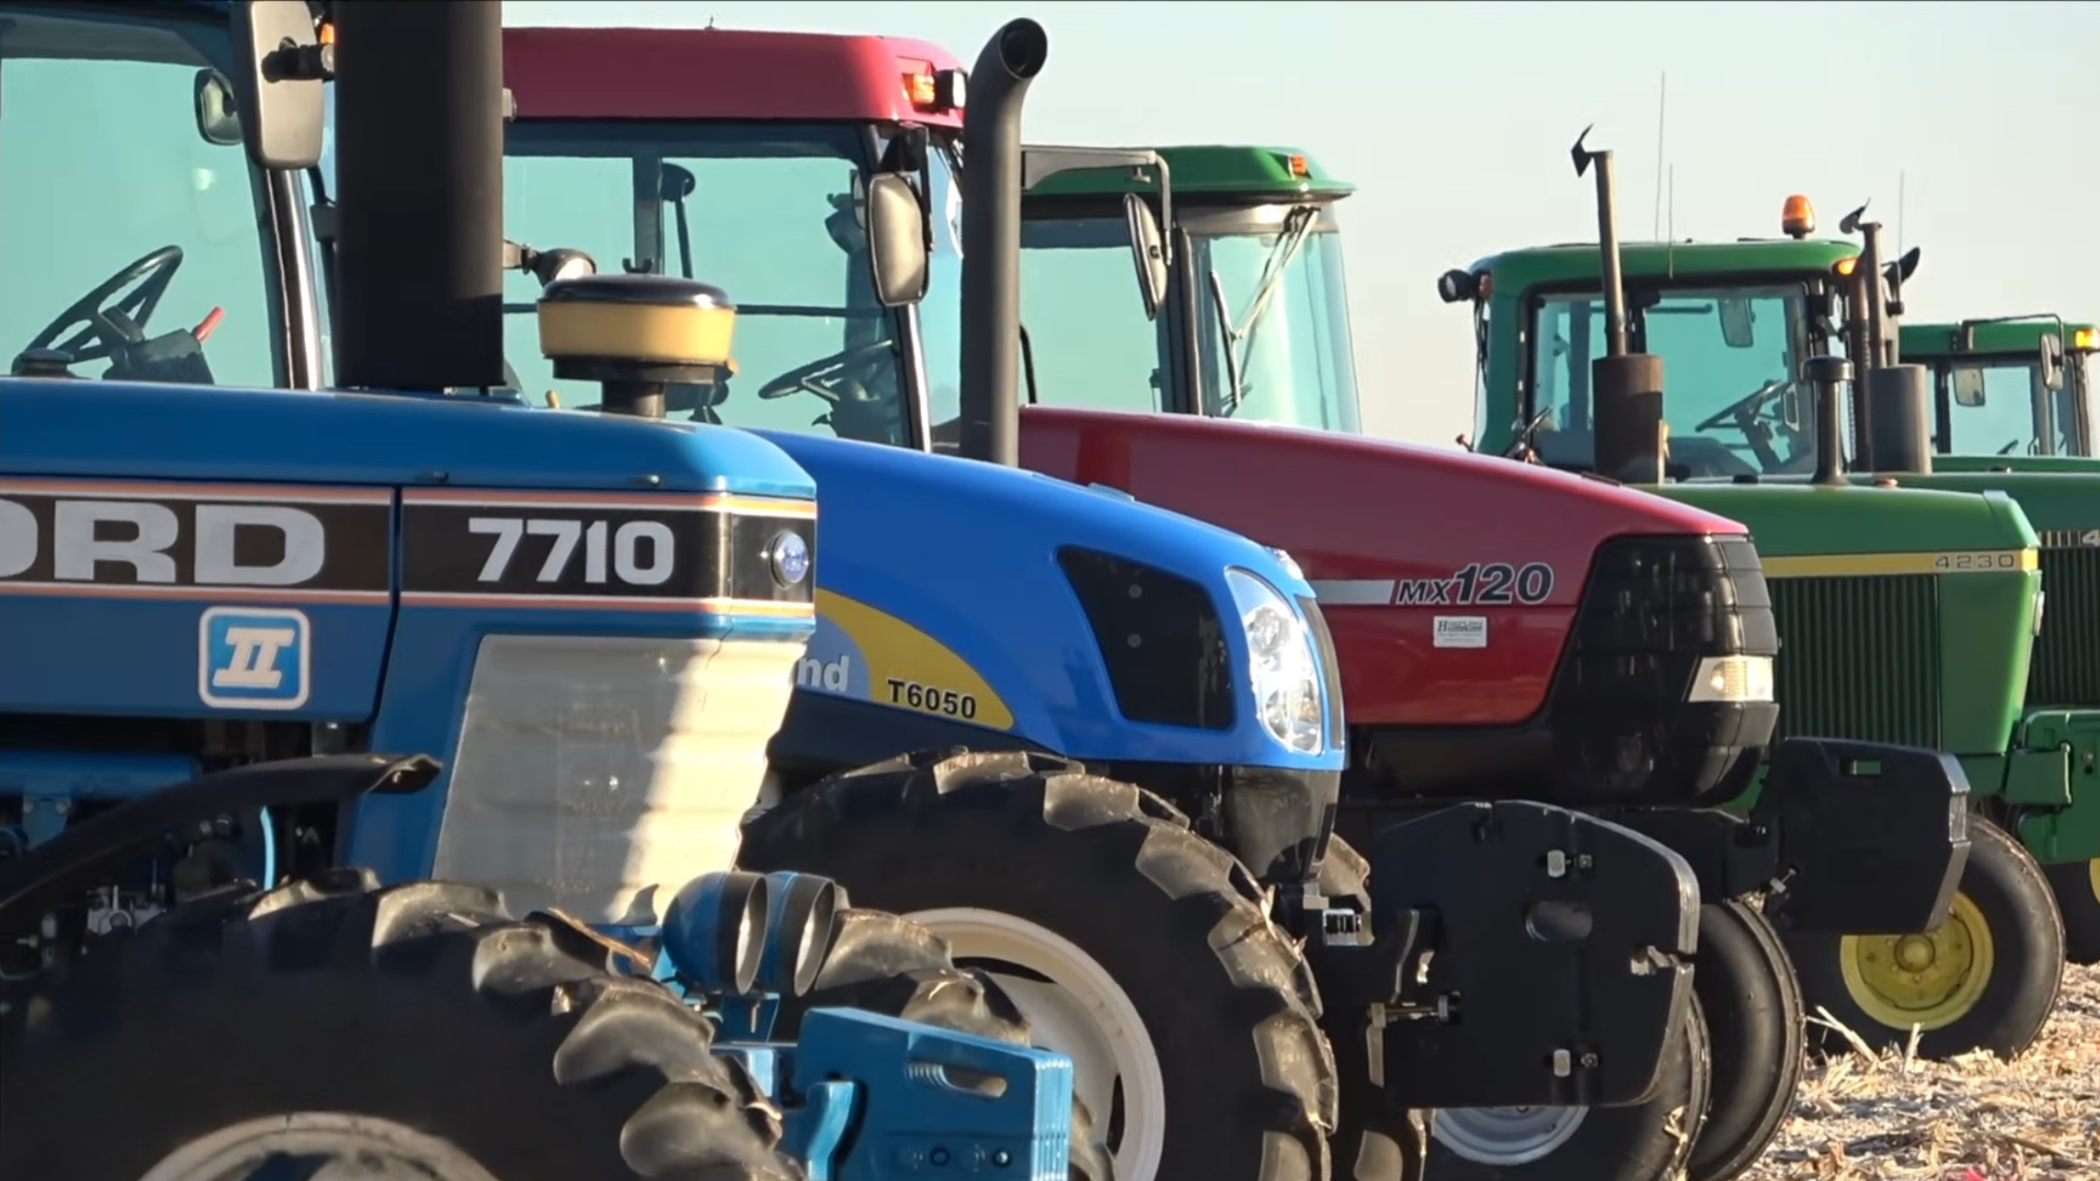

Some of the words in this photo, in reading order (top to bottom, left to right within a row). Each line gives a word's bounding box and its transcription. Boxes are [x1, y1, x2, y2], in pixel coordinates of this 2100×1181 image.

[468, 518, 675, 586] 7710
[1935, 554, 2014, 569] 4230
[1396, 562, 1554, 605] MX120
[888, 678, 976, 719] T6050
